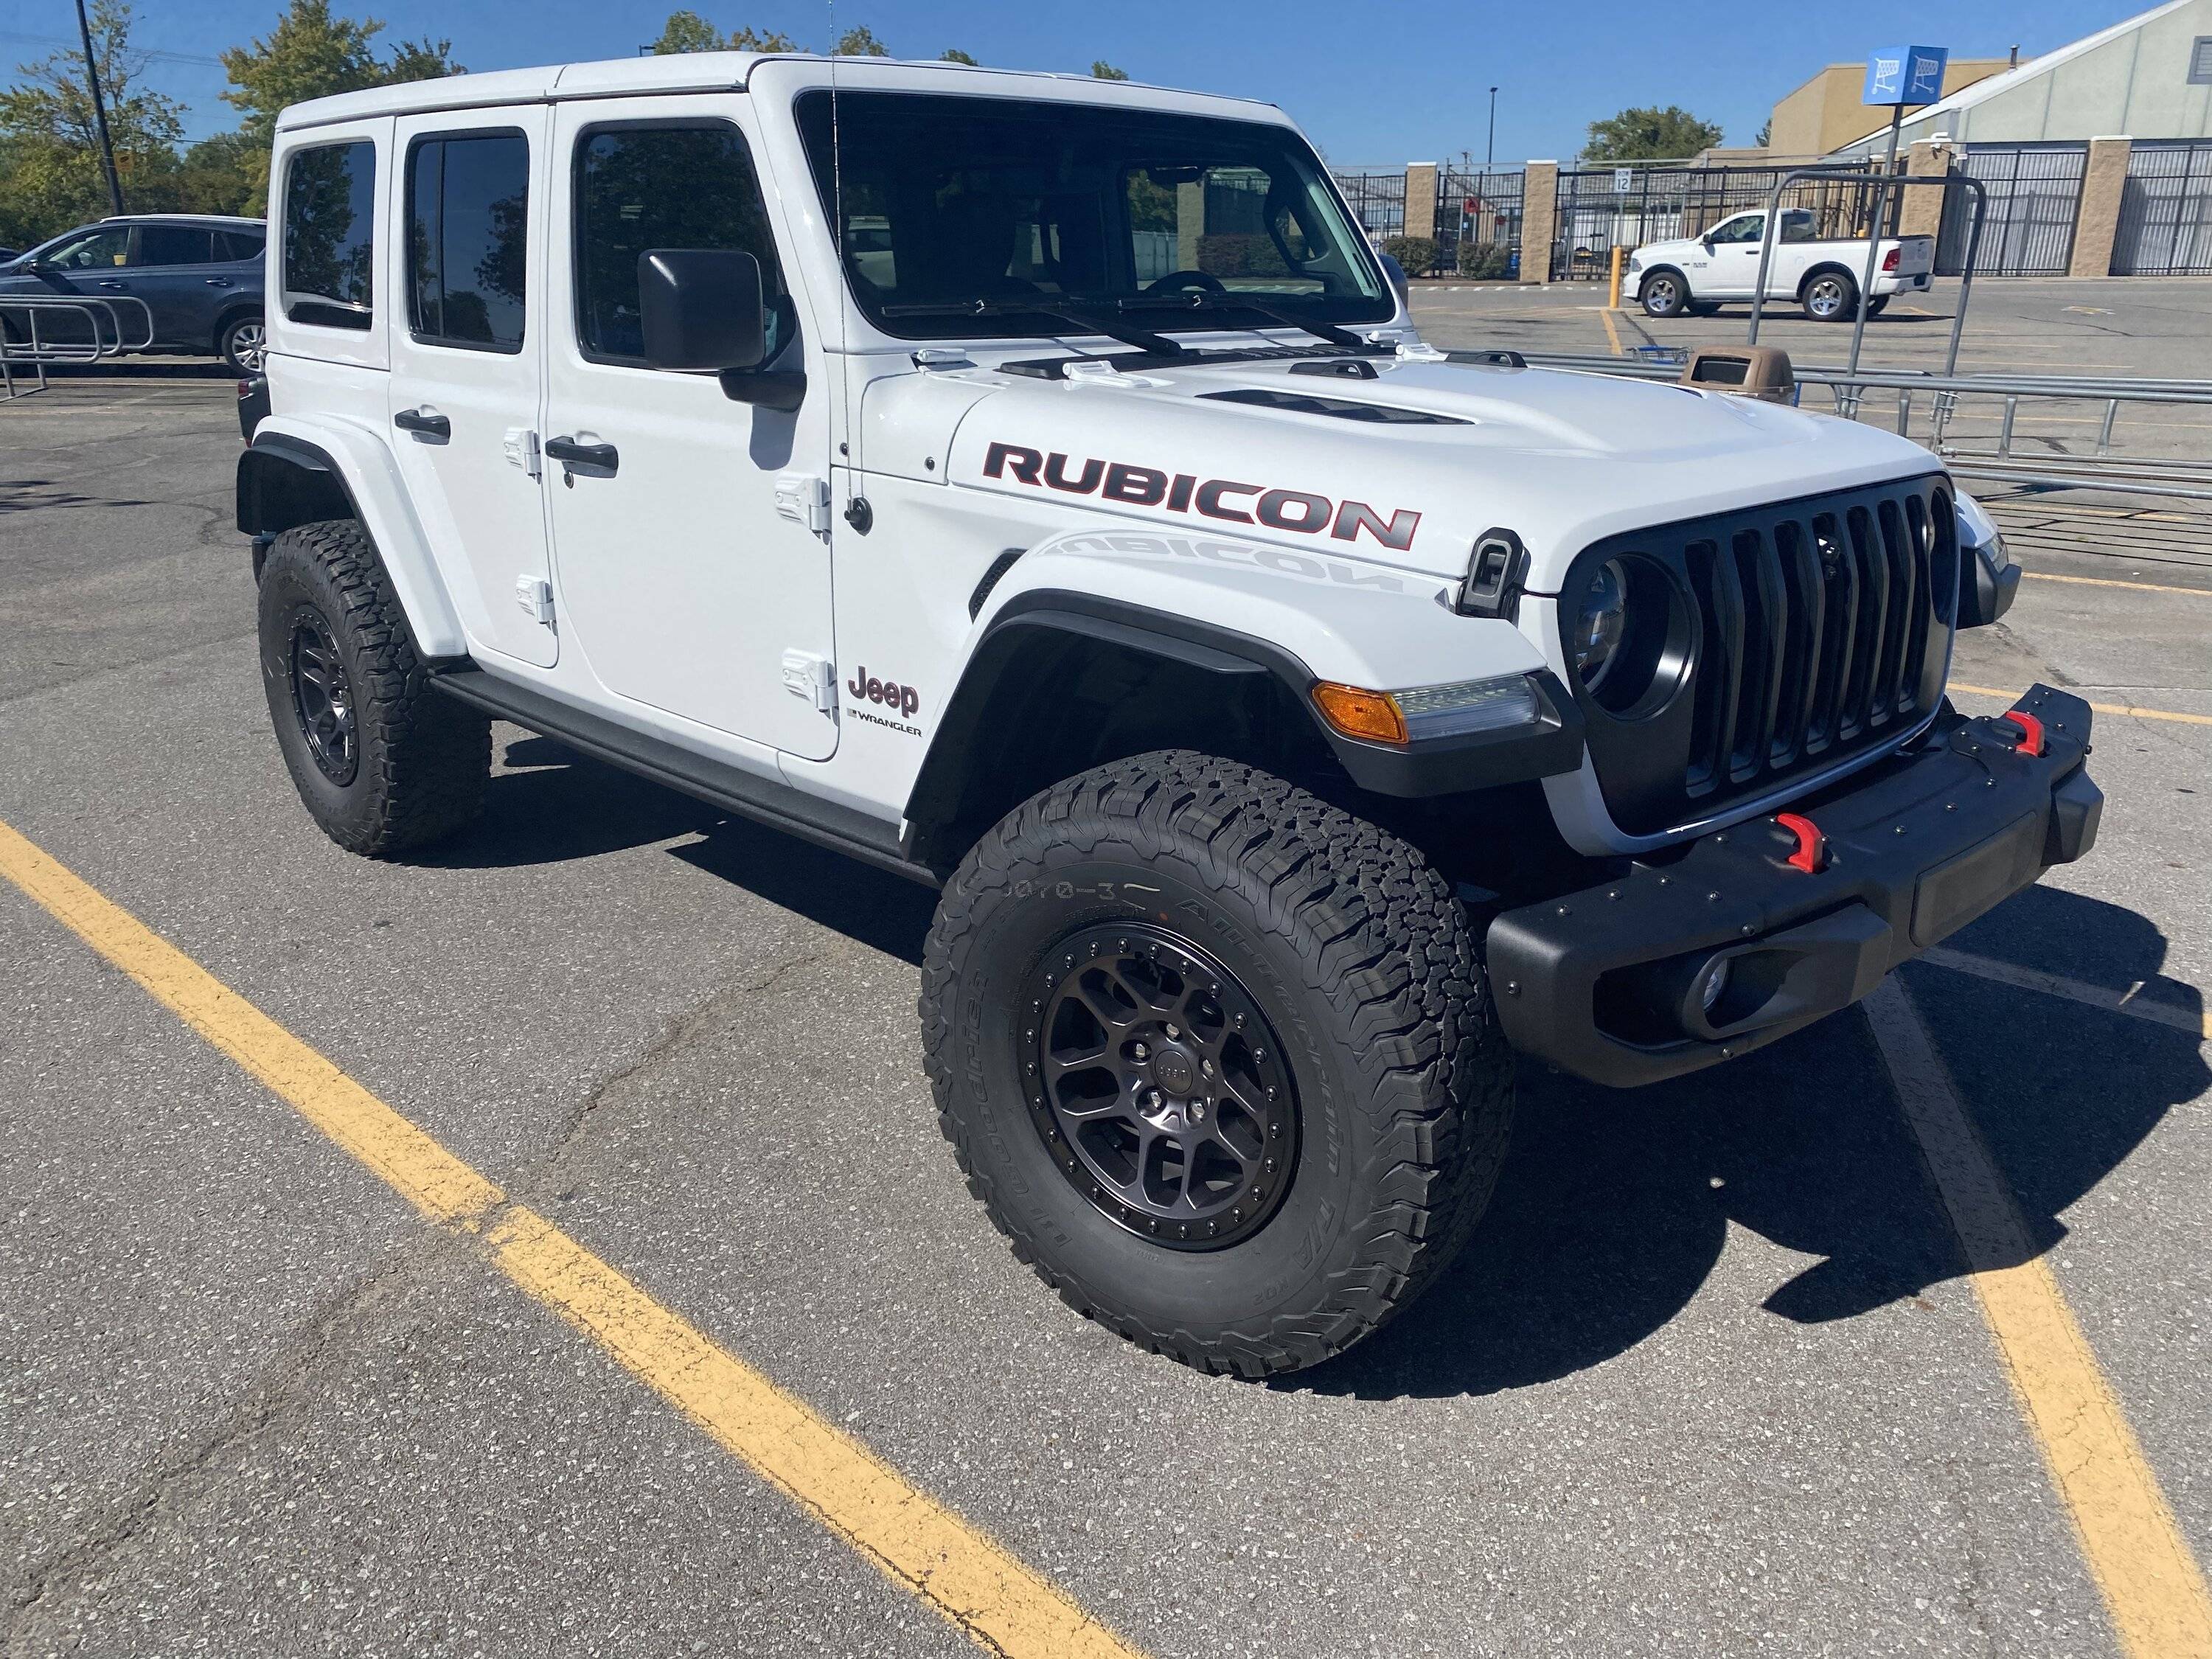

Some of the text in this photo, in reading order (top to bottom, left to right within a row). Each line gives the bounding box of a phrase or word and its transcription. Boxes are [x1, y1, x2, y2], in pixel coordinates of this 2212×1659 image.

[1617, 178, 1628, 189] 12
[983, 441, 1422, 552] RUBICON
[848, 666, 919, 719] Jeep
[858, 711, 922, 737] WRANGLER
